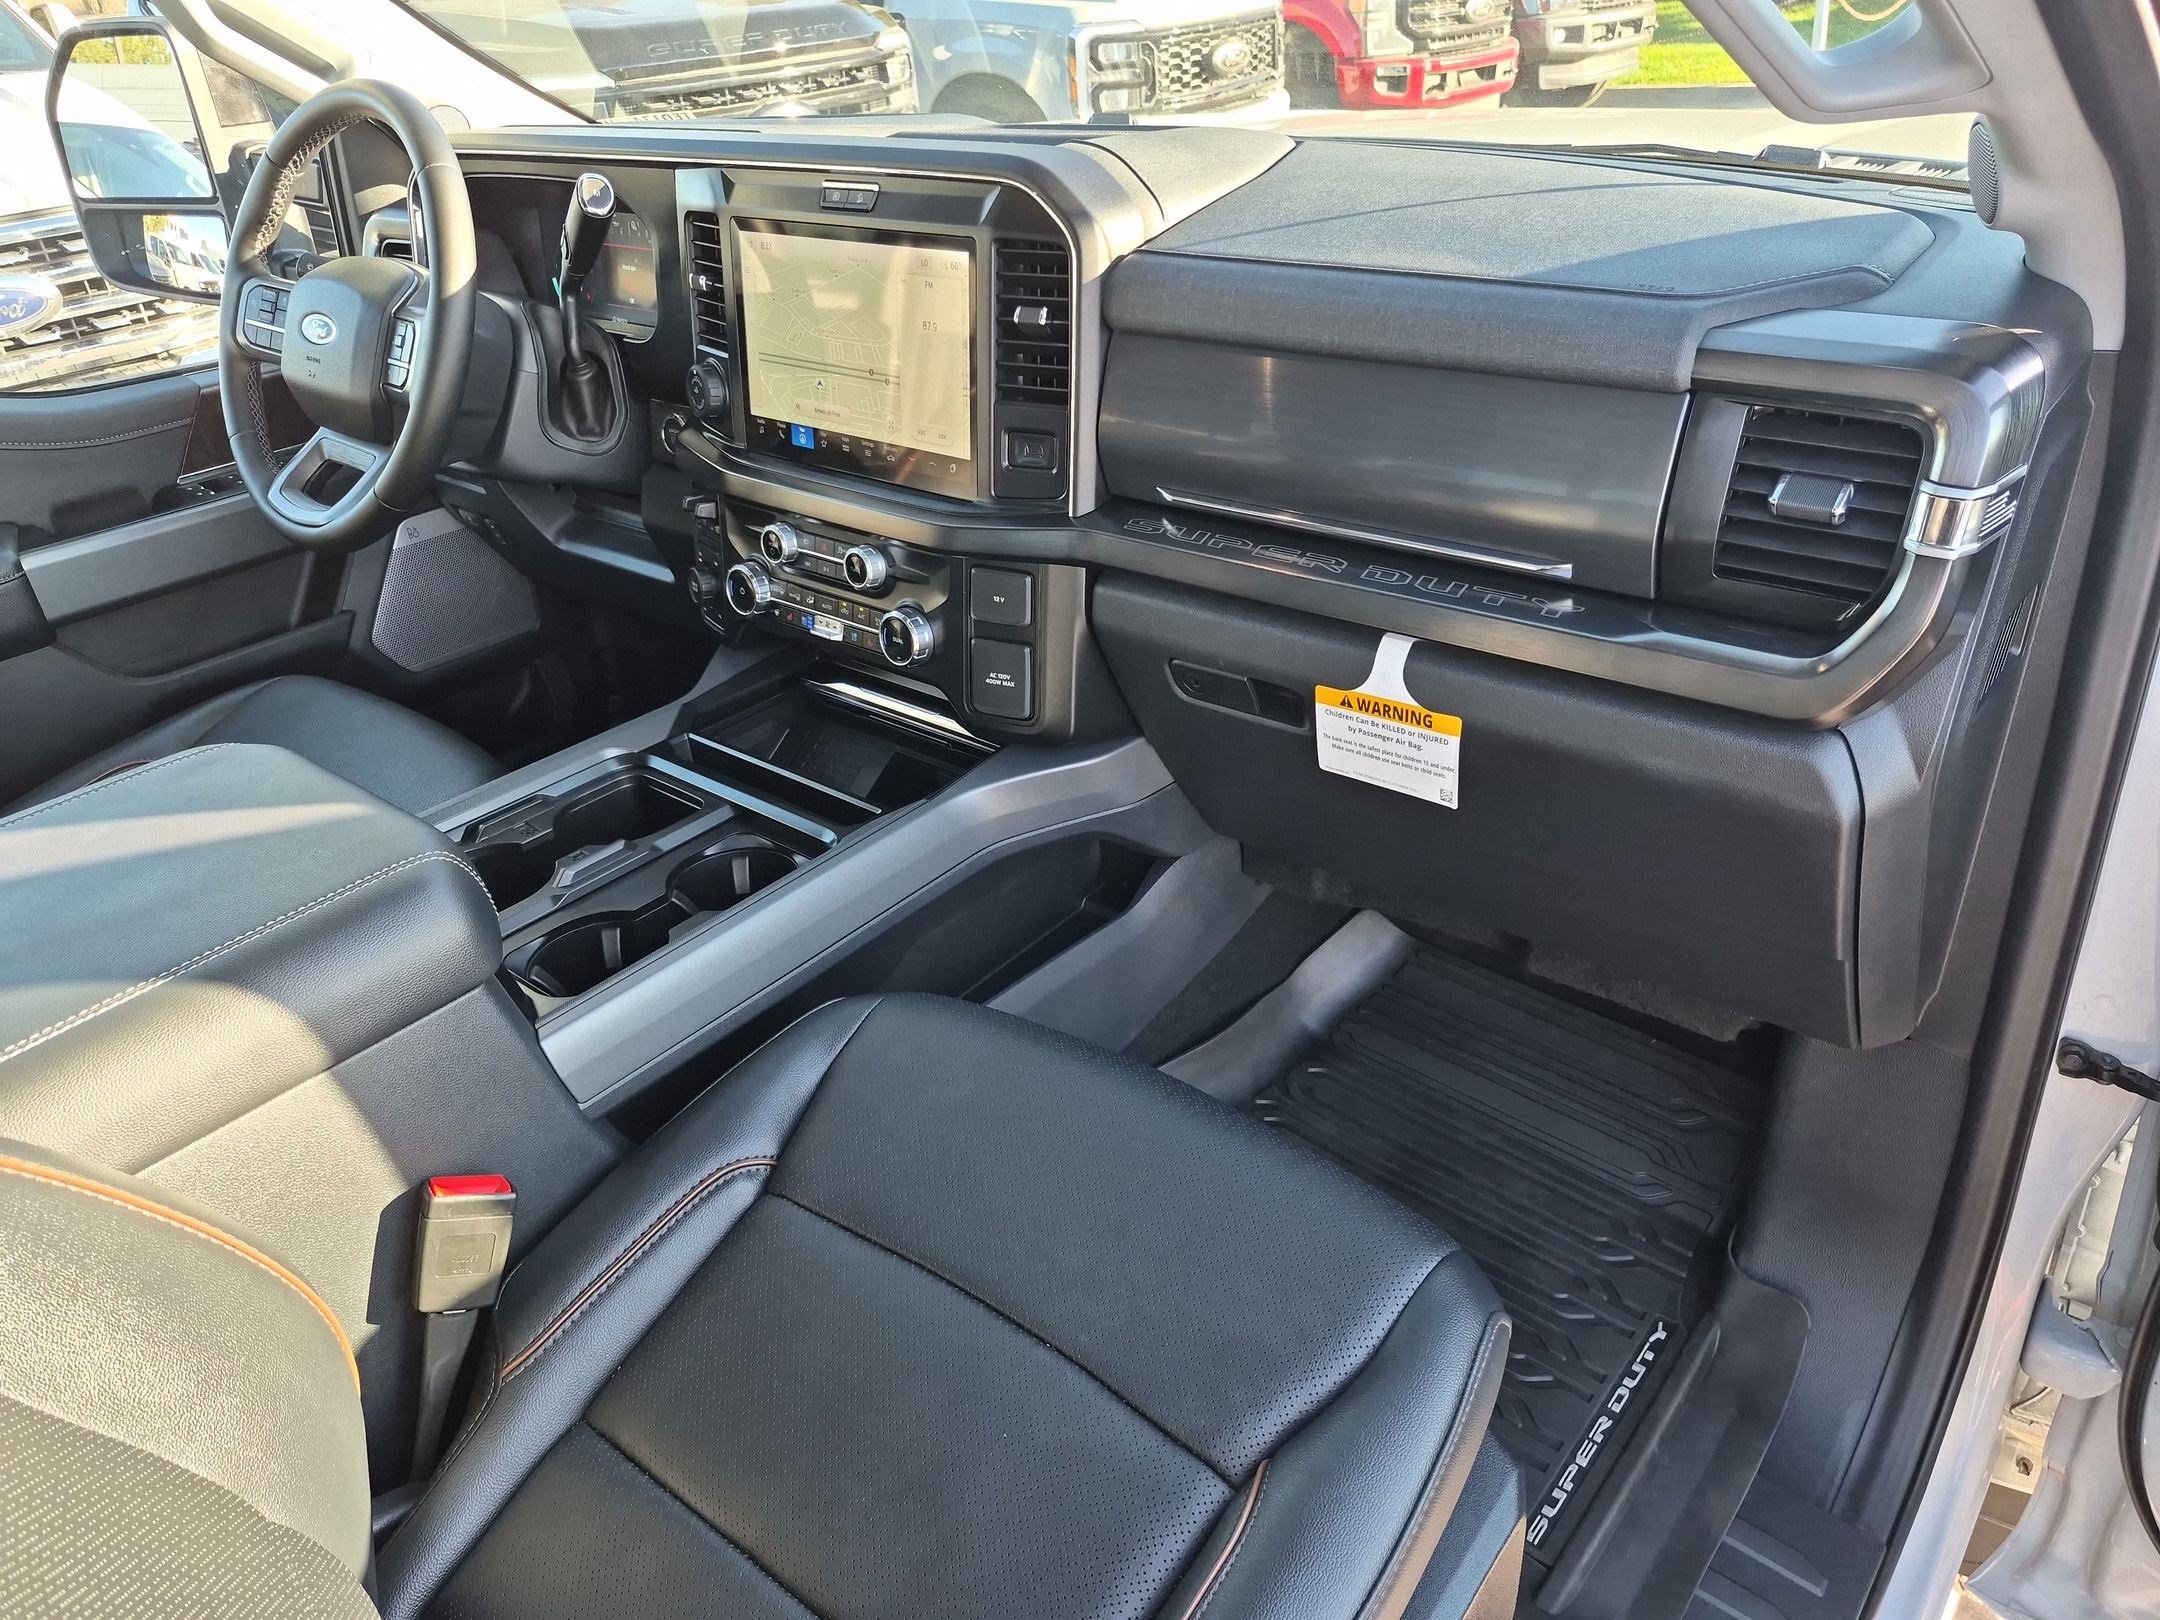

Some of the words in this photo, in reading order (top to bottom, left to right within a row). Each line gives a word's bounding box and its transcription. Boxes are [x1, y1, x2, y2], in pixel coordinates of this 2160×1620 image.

[922, 321, 938, 331] 87.9
[1123, 518, 1348, 574] SUPER
[1360, 564, 1586, 619] DUTY
[1356, 697, 1433, 728] WARNING
[1325, 708, 1354, 721] Children
[1356, 717, 1369, 726] Can
[1371, 720, 1379, 728] Be
[1382, 724, 1406, 735] KILLED
[1418, 732, 1449, 746] INJURED
[1348, 725, 1356, 734] by
[1359, 729, 1393, 742] Passenger
[1408, 741, 1423, 751] Bag.
[1362, 752, 1380, 760] children
[1402, 762, 1413, 770] belts
[1403, 755, 1422, 764] children
[1441, 765, 1456, 773] under.
[1526, 1415, 1613, 1546] SUPER
[1607, 1321, 1668, 1414] DUTY
